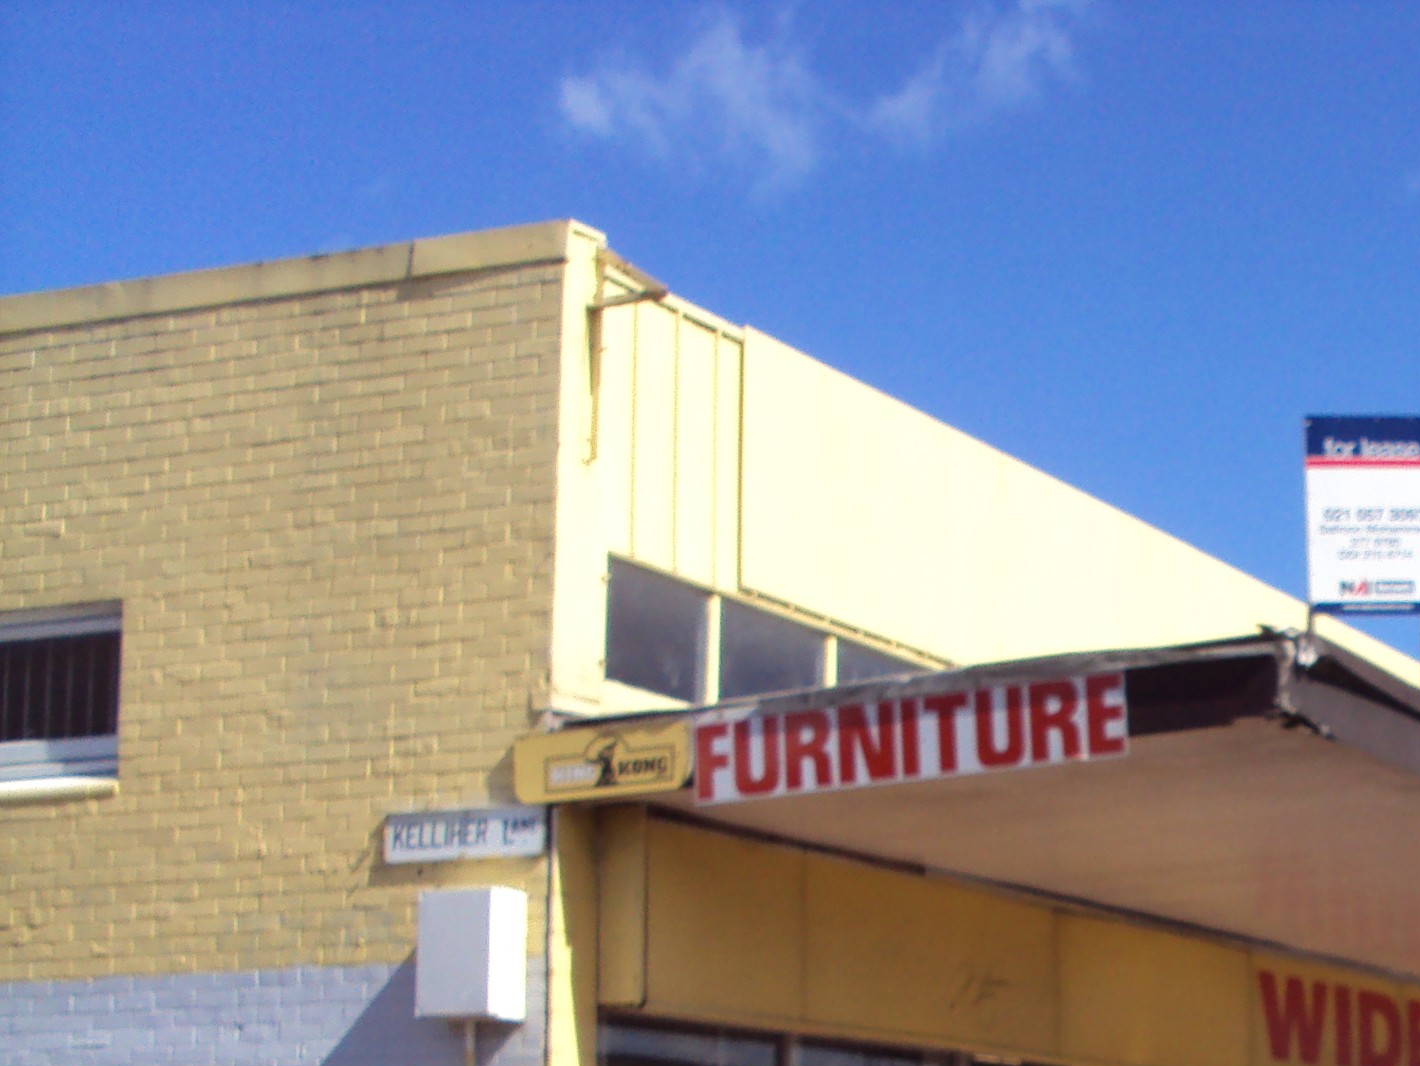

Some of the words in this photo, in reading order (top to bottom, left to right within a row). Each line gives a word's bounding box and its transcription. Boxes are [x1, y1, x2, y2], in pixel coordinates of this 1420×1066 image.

[1323, 436, 1354, 457] for
[697, 674, 1126, 799] FURNITURE
[616, 755, 668, 776] KONG
